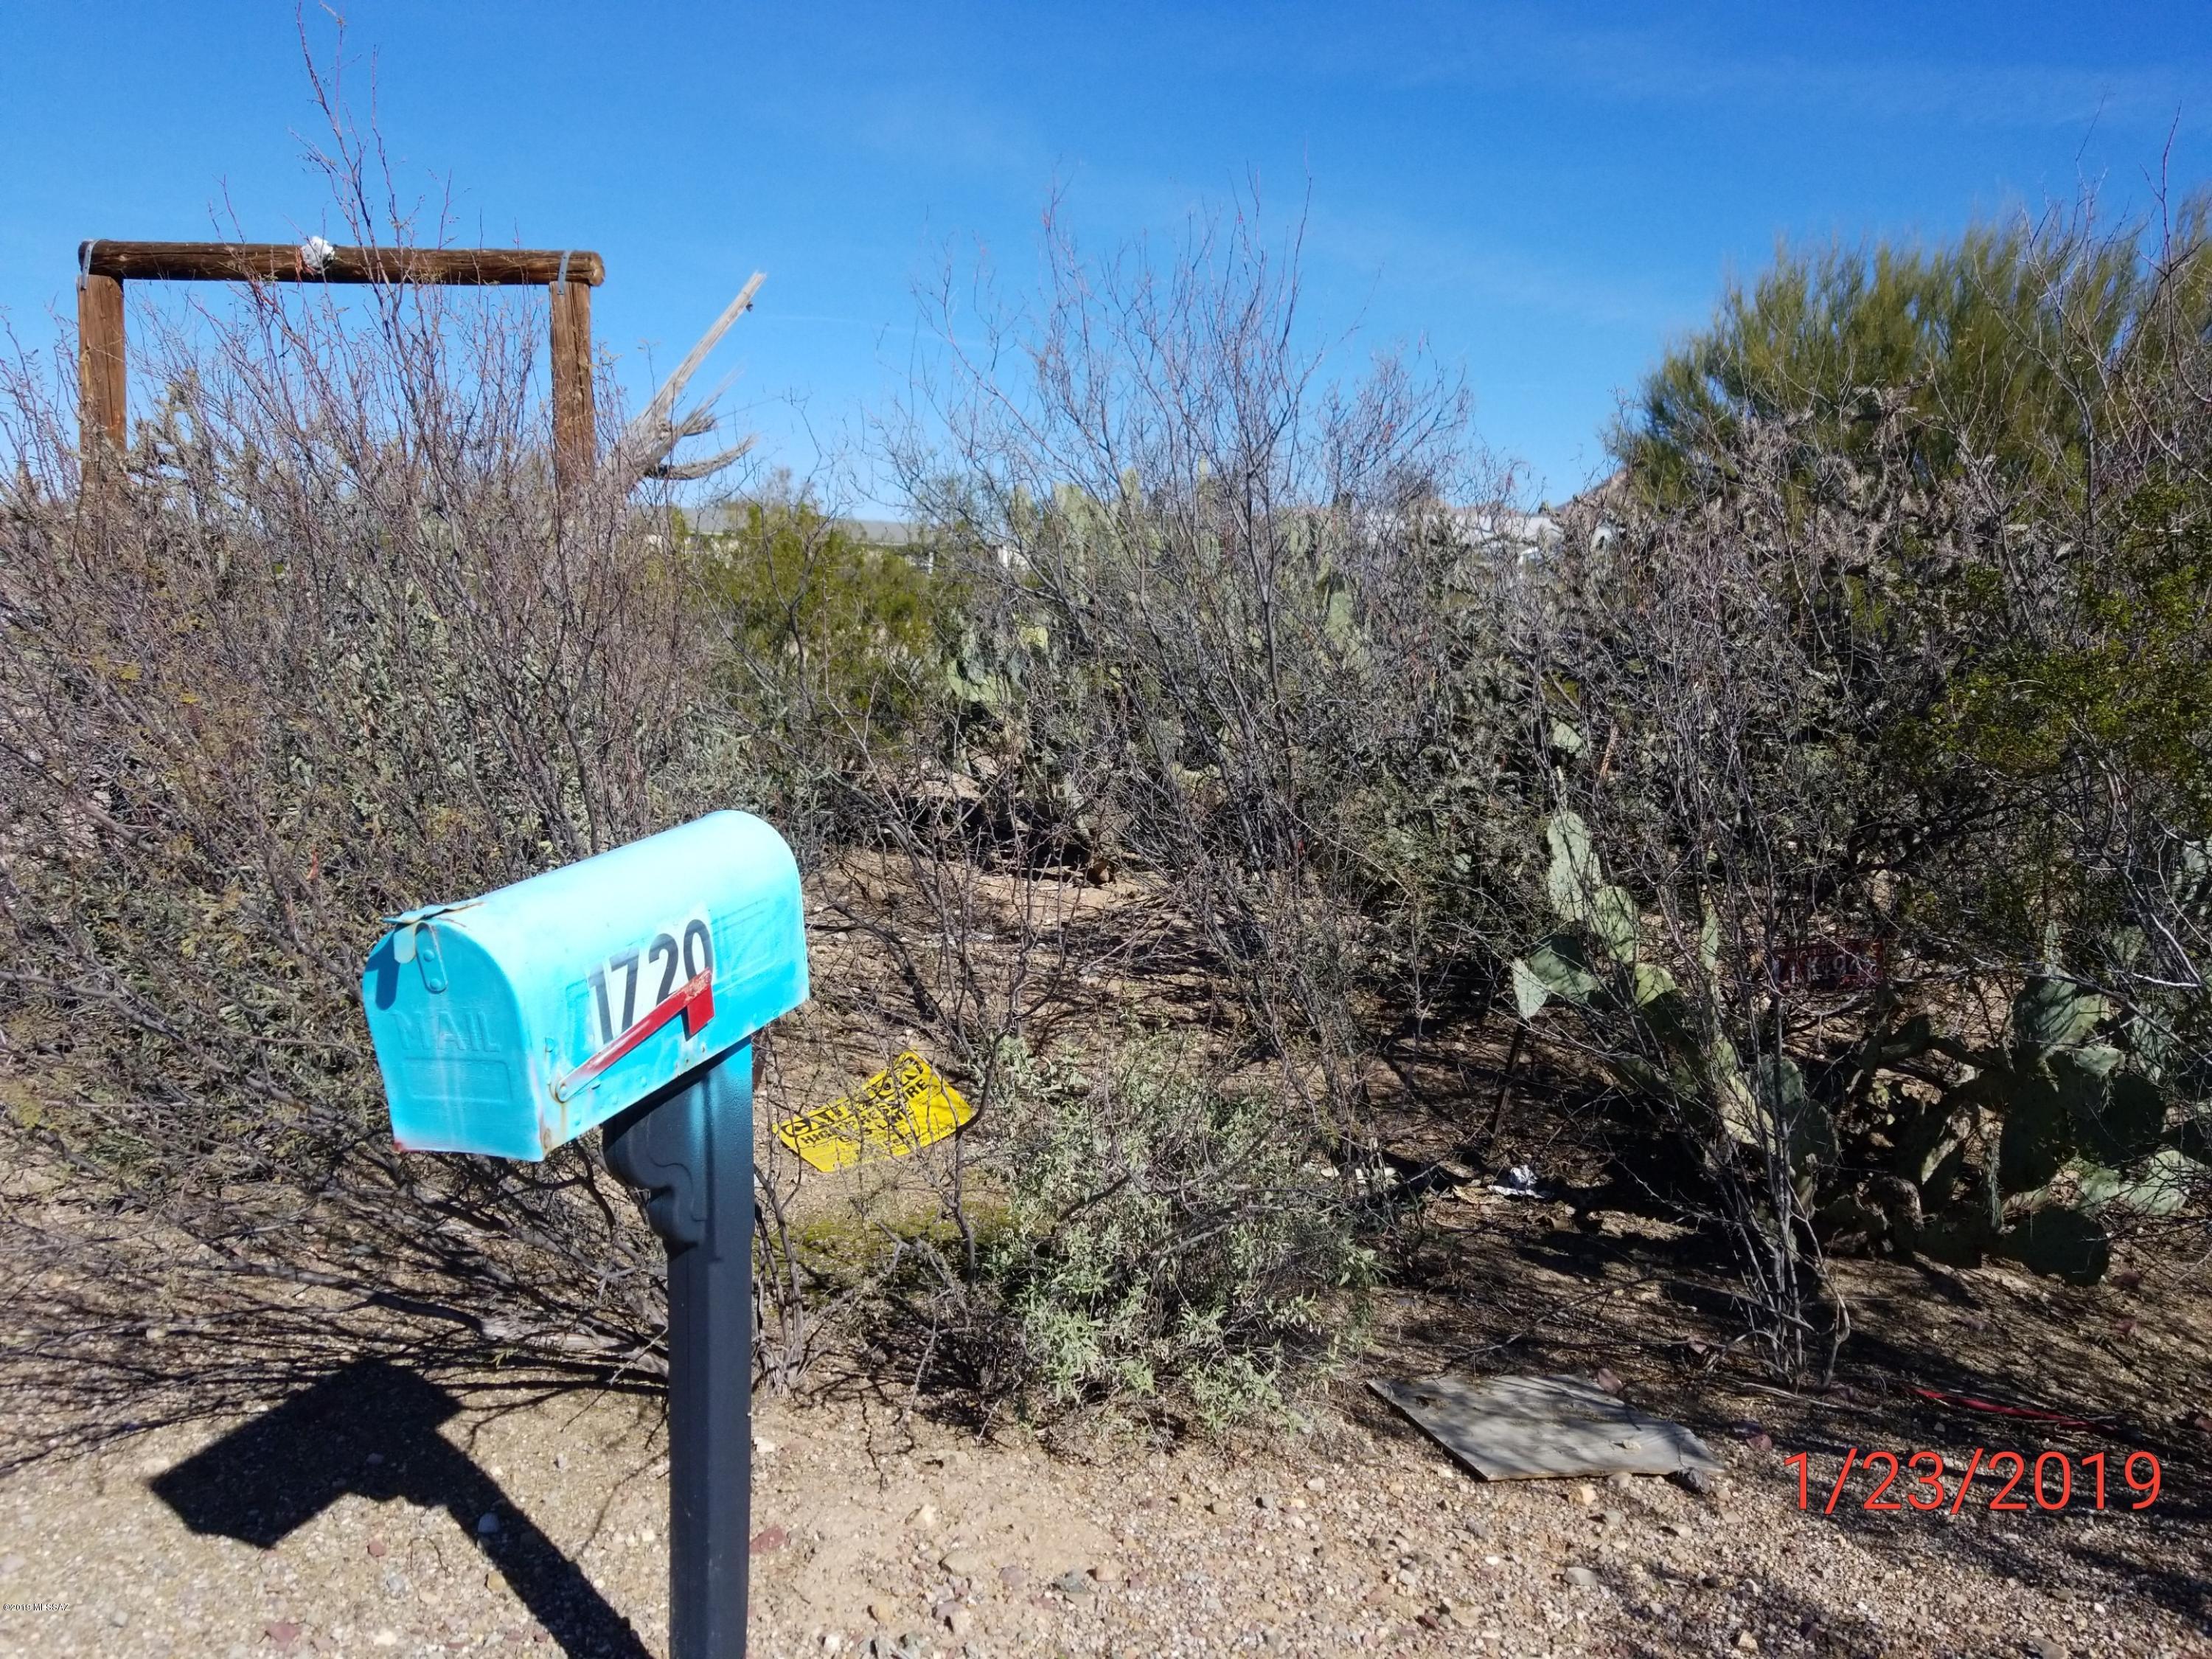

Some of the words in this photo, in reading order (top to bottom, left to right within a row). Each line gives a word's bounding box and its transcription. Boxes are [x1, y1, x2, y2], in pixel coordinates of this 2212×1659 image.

[590, 919, 714, 1046] 1720
[390, 1009, 501, 1053] MAIL
[782, 1055, 923, 1136] CAUON
